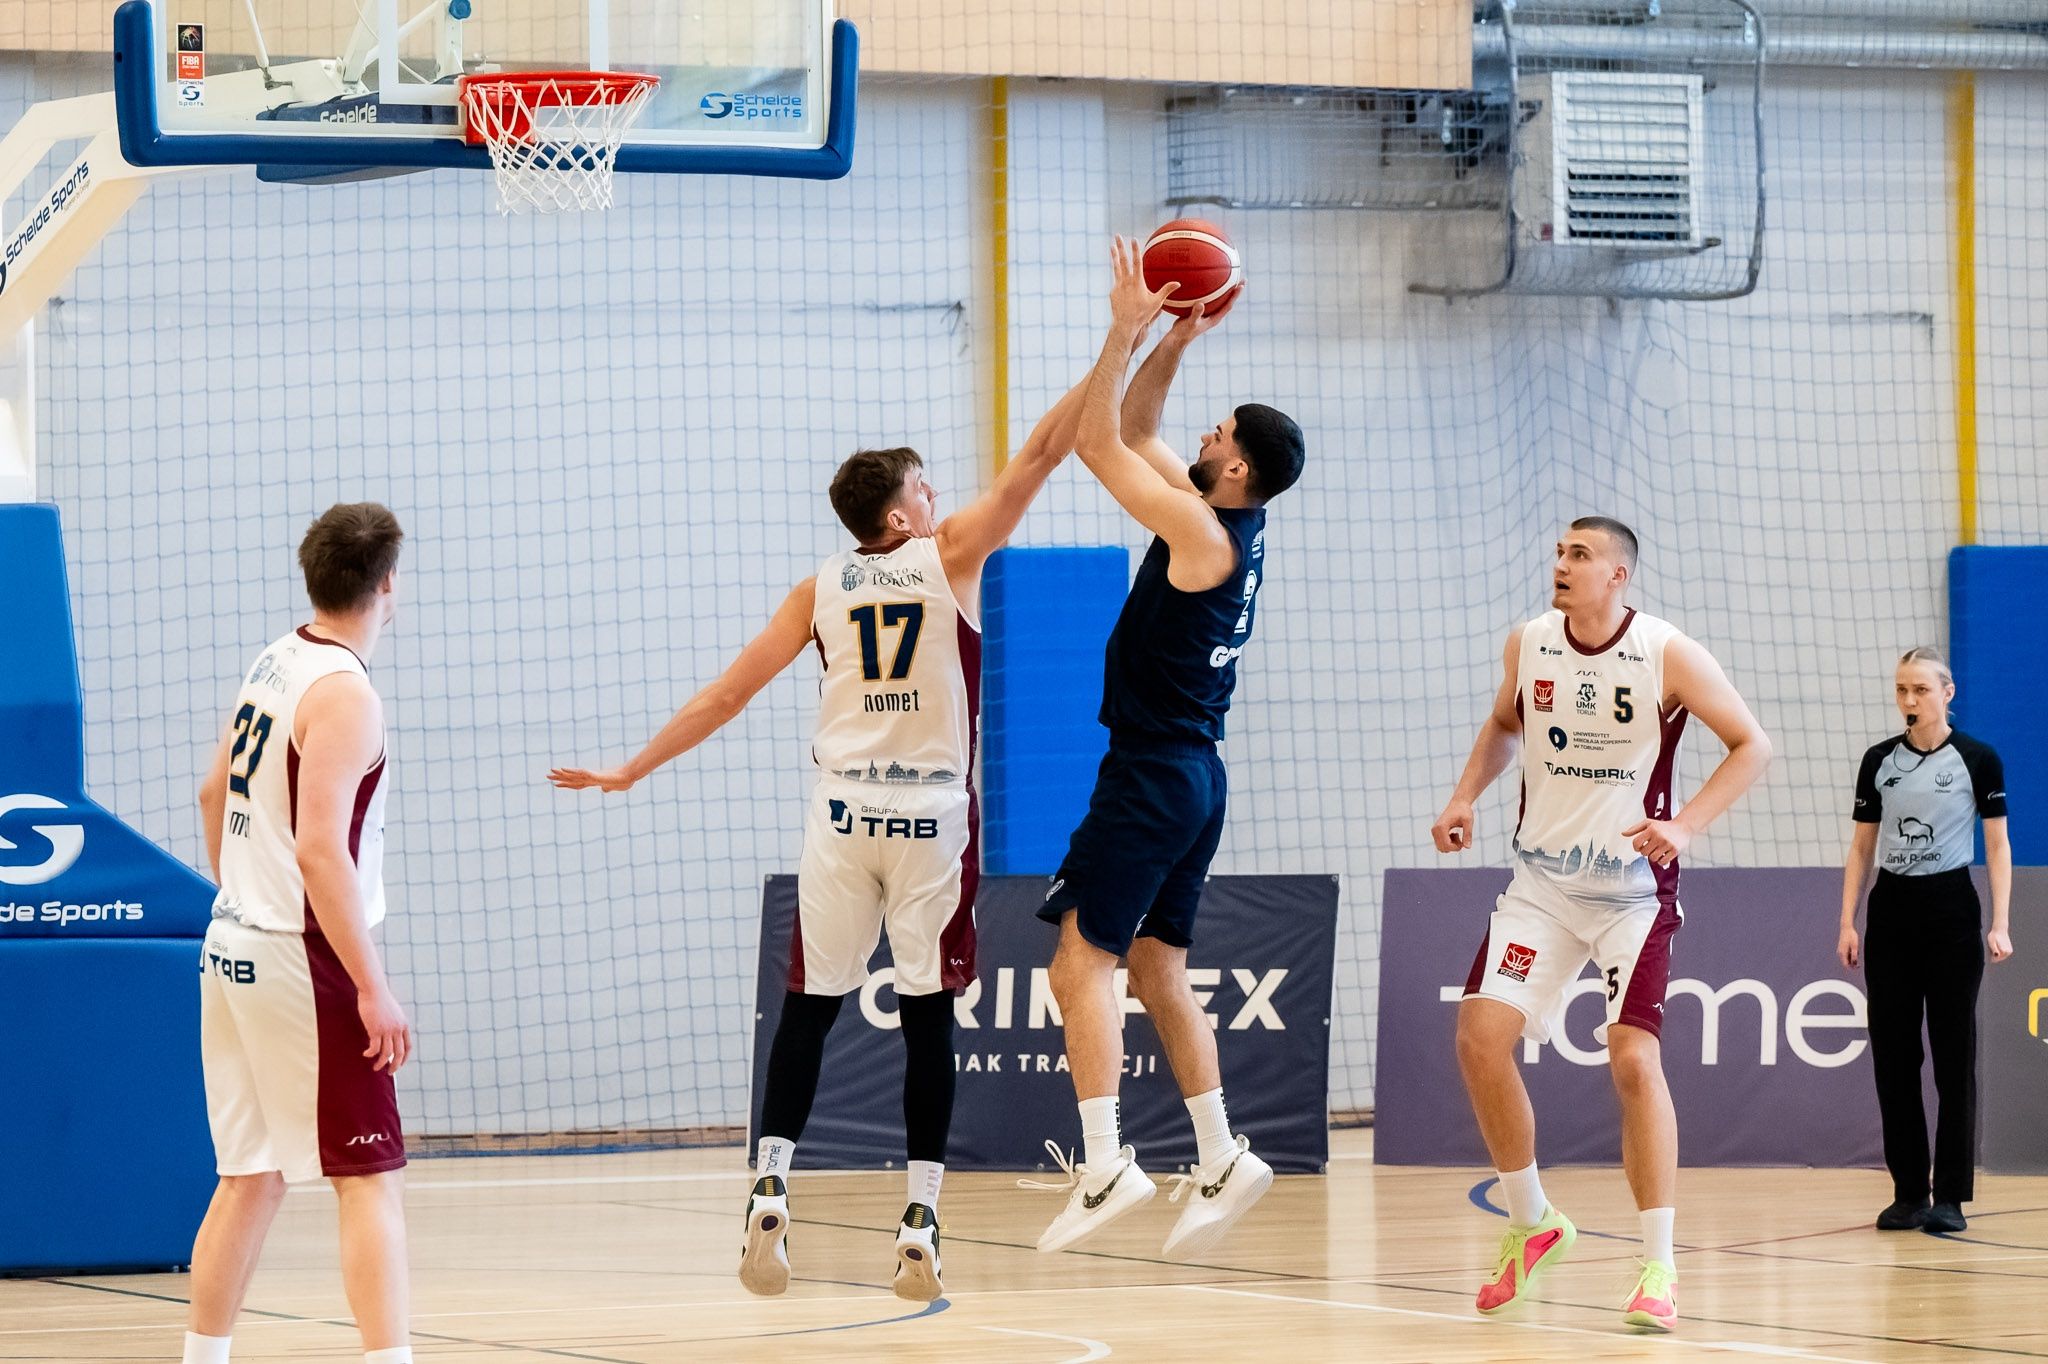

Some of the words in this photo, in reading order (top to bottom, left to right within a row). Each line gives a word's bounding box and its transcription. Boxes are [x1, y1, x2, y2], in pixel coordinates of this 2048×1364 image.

[182, 56, 200, 66] FIBA
[734, 94, 802, 106] Schelde
[734, 106, 802, 120] Sports
[6, 206, 51, 266] Schelde
[51, 161, 89, 213] Sports
[847, 600, 926, 683] 17
[864, 690, 920, 712] nomet
[1576, 701, 1596, 710] UMK
[1613, 685, 1634, 725] 5
[860, 805, 899, 815] GRUPA
[860, 816, 939, 839] TRB
[40, 900, 144, 926] Sports
[1607, 966, 1619, 1002] 5
